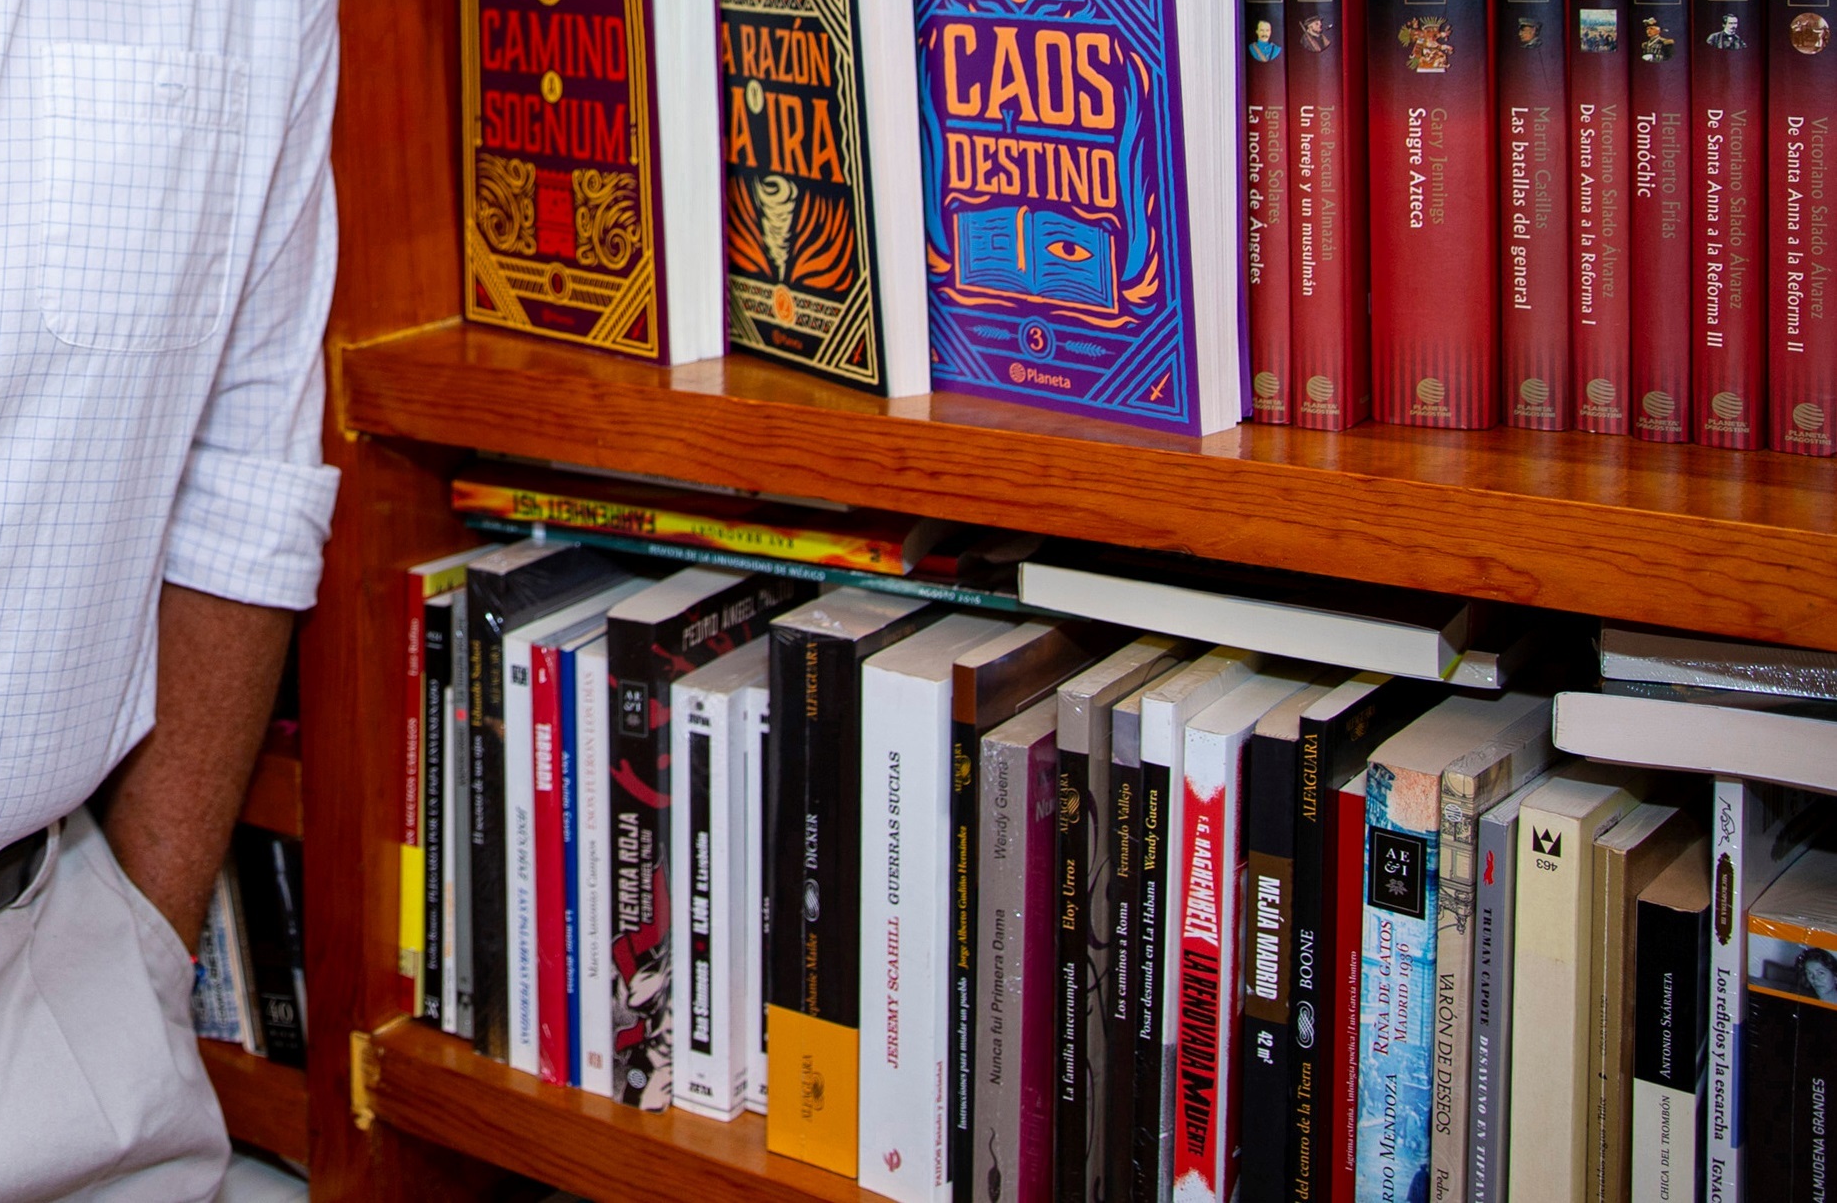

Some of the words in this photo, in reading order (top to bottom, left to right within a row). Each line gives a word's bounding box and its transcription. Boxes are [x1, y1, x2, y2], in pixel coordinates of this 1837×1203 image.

[481, 9, 627, 81] CAMINO
[741, 17, 832, 88] RAZÓN
[943, 23, 1115, 130] CAOS
[485, 91, 627, 166] SOGNUM
[1002, 110, 1014, 133] Y
[1249, 105, 1263, 123] La
[1300, 105, 1314, 127] Un
[1406, 108, 1426, 165] Sangre
[1512, 107, 1528, 134] Las
[1580, 104, 1594, 123] De
[767, 92, 844, 184] IRA
[1249, 131, 1264, 182] noche
[1300, 133, 1314, 177] hereje
[1580, 129, 1595, 168] Santa
[1636, 112, 1656, 198] Tomóchic
[945, 132, 1117, 208] DESTINO
[1299, 182, 1311, 192] y
[1512, 141, 1530, 207] batallas
[1581, 174, 1595, 212] Anna
[1249, 189, 1264, 210] de
[1301, 198, 1313, 216] un
[1410, 171, 1426, 228] Azteca
[1581, 218, 1592, 228] a
[1514, 213, 1530, 239] del
[1581, 234, 1596, 246] la
[1249, 216, 1267, 285] Ángeles
[1302, 222, 1316, 296] musulmán
[1511, 246, 1532, 310] general
[1581, 252, 1596, 314] Reforma
[1029, 327, 1044, 351] 3
[1026, 368, 1071, 389] Planeta
[511, 490, 543, 519] 451
[547, 493, 657, 535] FAHRENHEIT
[536, 723, 552, 792] TABOADA
[1302, 733, 1318, 823] ALFAGUARA
[888, 751, 901, 816] SUCIAS
[996, 760, 1009, 809] Guerra
[1118, 783, 1131, 822] Vallejo
[618, 812, 640, 860] ROJA
[806, 814, 818, 869] DICKER
[994, 813, 1011, 860] Wendy
[1117, 826, 1129, 878] Fernando
[887, 821, 901, 905] GUERRAS
[1536, 857, 1558, 873] 463
[618, 868, 640, 933] TIERRA
[1143, 881, 1155, 922] Habana
[1183, 838, 1219, 947] HAGHENBECK
[1256, 875, 1284, 930] MEJÍA
[992, 908, 1005, 954] Dama
[1116, 902, 1129, 936] Roma
[1143, 925, 1154, 940] La
[1482, 908, 1493, 966] TRUMAN
[887, 916, 900, 991] SCAHILL
[1118, 948, 1127, 997] caminos
[1144, 943, 1153, 957] en
[1183, 948, 1218, 975] LA
[1255, 931, 1280, 1000] MADRID
[1300, 929, 1314, 989] BOONE
[1379, 920, 1393, 977] GATOS
[1396, 942, 1413, 978] 1936
[991, 959, 1004, 1013] Primera
[1063, 962, 1077, 1035] interrumpida
[1141, 961, 1153, 1004] desnuda
[1379, 982, 1390, 1005] DE
[1480, 971, 1490, 1026] CAPOTE
[1660, 972, 1673, 1028] SKÁRMETA
[1717, 967, 1730, 993] Los
[989, 1017, 1003, 1035] fui
[1115, 1001, 1126, 1020] Los
[1139, 1008, 1153, 1041] Posar
[1182, 971, 1218, 1073] RENOVADA
[1394, 983, 1409, 1044] MADRID
[1438, 973, 1458, 1038] VARÓN
[1713, 996, 1731, 1044] reflejos
[887, 996, 900, 1069] JEREMY
[1372, 1012, 1390, 1056] RIÑA
[1437, 1040, 1452, 1066] DE
[1659, 1029, 1672, 1080] ANTONIO
[1712, 1047, 1725, 1061] y
[990, 1038, 1002, 1085] Nunca
[1063, 1038, 1075, 1083] familia
[1297, 1062, 1311, 1099] Tierra
[1715, 1062, 1729, 1076] la
[1063, 1085, 1074, 1101] La
[1182, 1070, 1215, 1157] MUERTE
[1379, 1073, 1397, 1161] MENDOZA
[1436, 1069, 1452, 1136] DESEOS
[1714, 1080, 1729, 1141] escarcha
[1812, 1078, 1825, 1134] GRANDES
[1659, 1095, 1670, 1142] TROMBÓN
[1660, 1144, 1669, 1166] DEL
